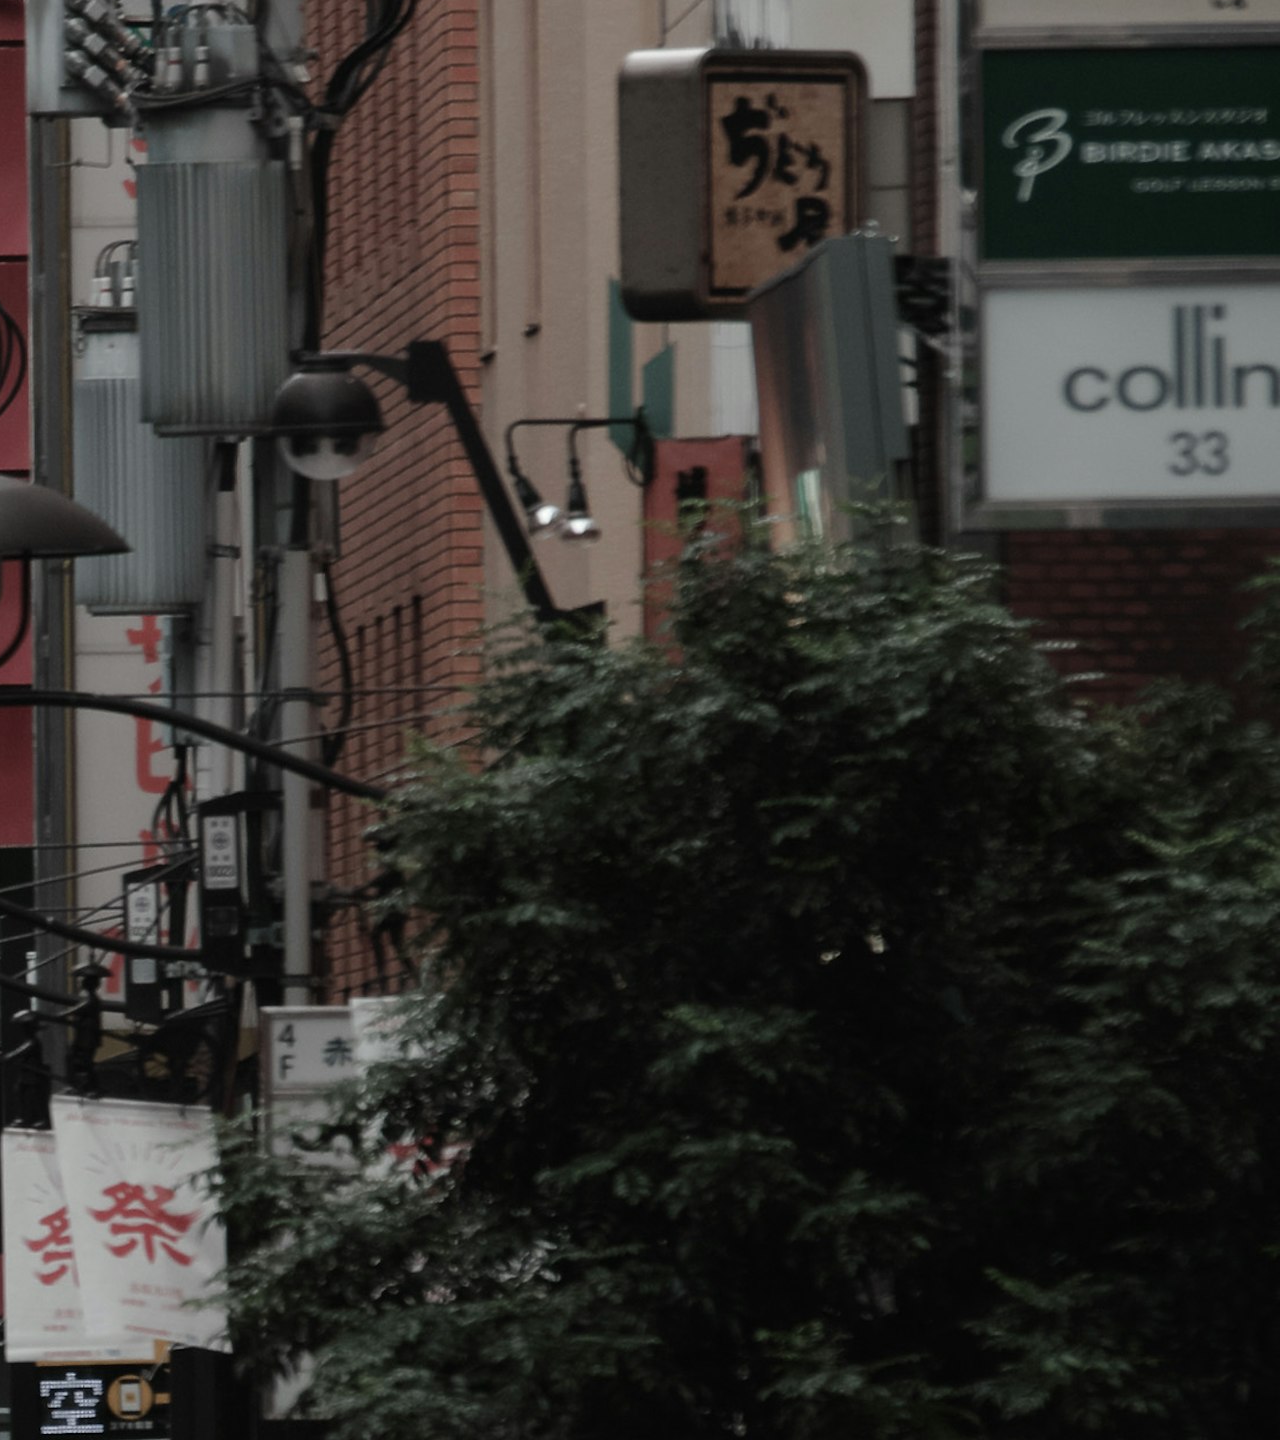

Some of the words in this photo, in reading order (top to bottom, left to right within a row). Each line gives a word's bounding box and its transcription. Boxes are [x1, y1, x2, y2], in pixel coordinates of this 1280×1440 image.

[1080, 140, 1192, 163] BIRDIE
[1167, 431, 1230, 476] 33
[85, 1181, 203, 1267] 祭
[40, 1372, 104, 1435] 空
